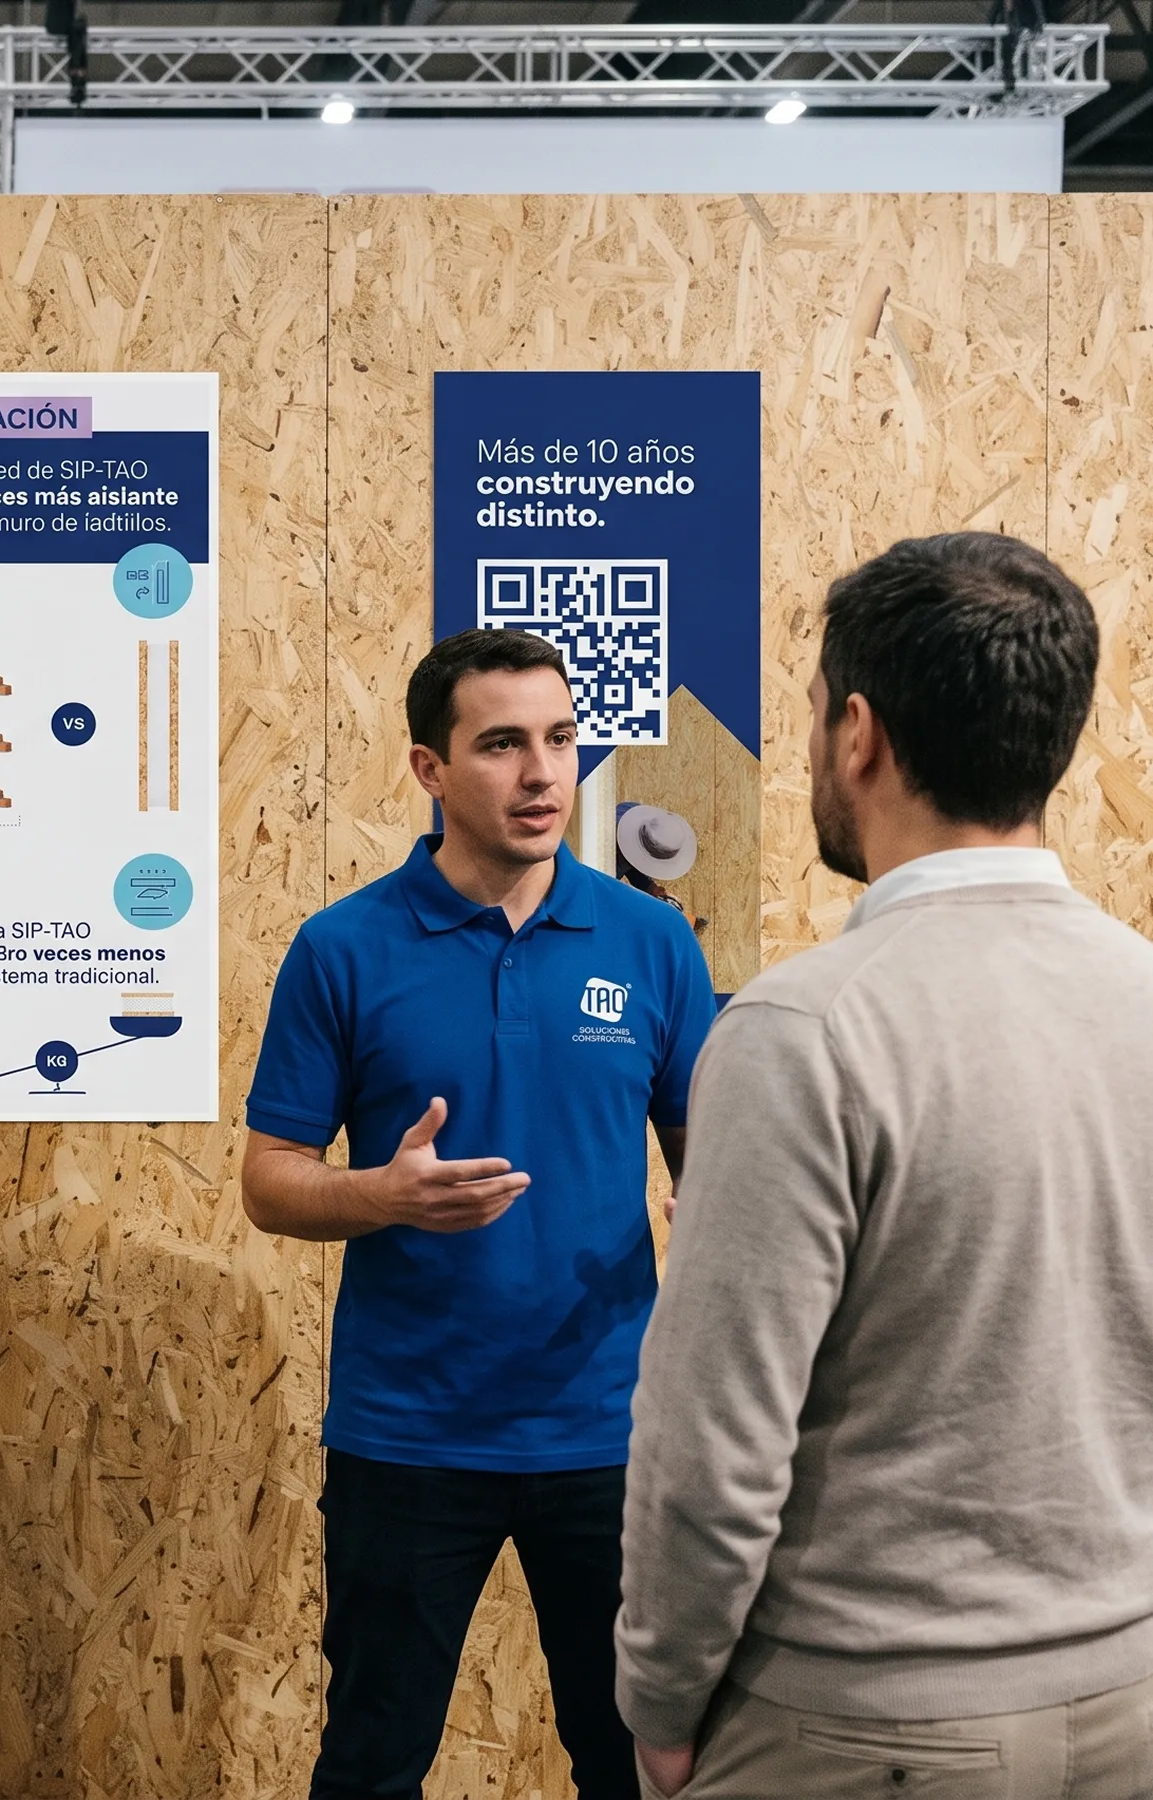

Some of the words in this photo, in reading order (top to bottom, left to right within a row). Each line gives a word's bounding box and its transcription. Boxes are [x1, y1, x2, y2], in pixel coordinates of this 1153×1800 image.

[478, 437, 535, 464] Más
[544, 438, 579, 464] de
[586, 438, 618, 464] 10
[627, 438, 695, 464] años
[27, 460, 54, 480] de
[60, 459, 148, 480] SIP-TAO
[476, 469, 695, 501] construyendo
[35, 485, 82, 506] más
[87, 485, 179, 506] aislante
[51, 512, 78, 532] de
[476, 501, 606, 528] distinto.
[62, 717, 85, 730] VS
[11, 921, 91, 939] SIP-TAO
[33, 948, 92, 962] veces
[97, 948, 166, 962] menos
[54, 967, 159, 985] tradicional.
[578, 1026, 630, 1036] SOLUCIONES
[47, 1055, 67, 1067] KG
